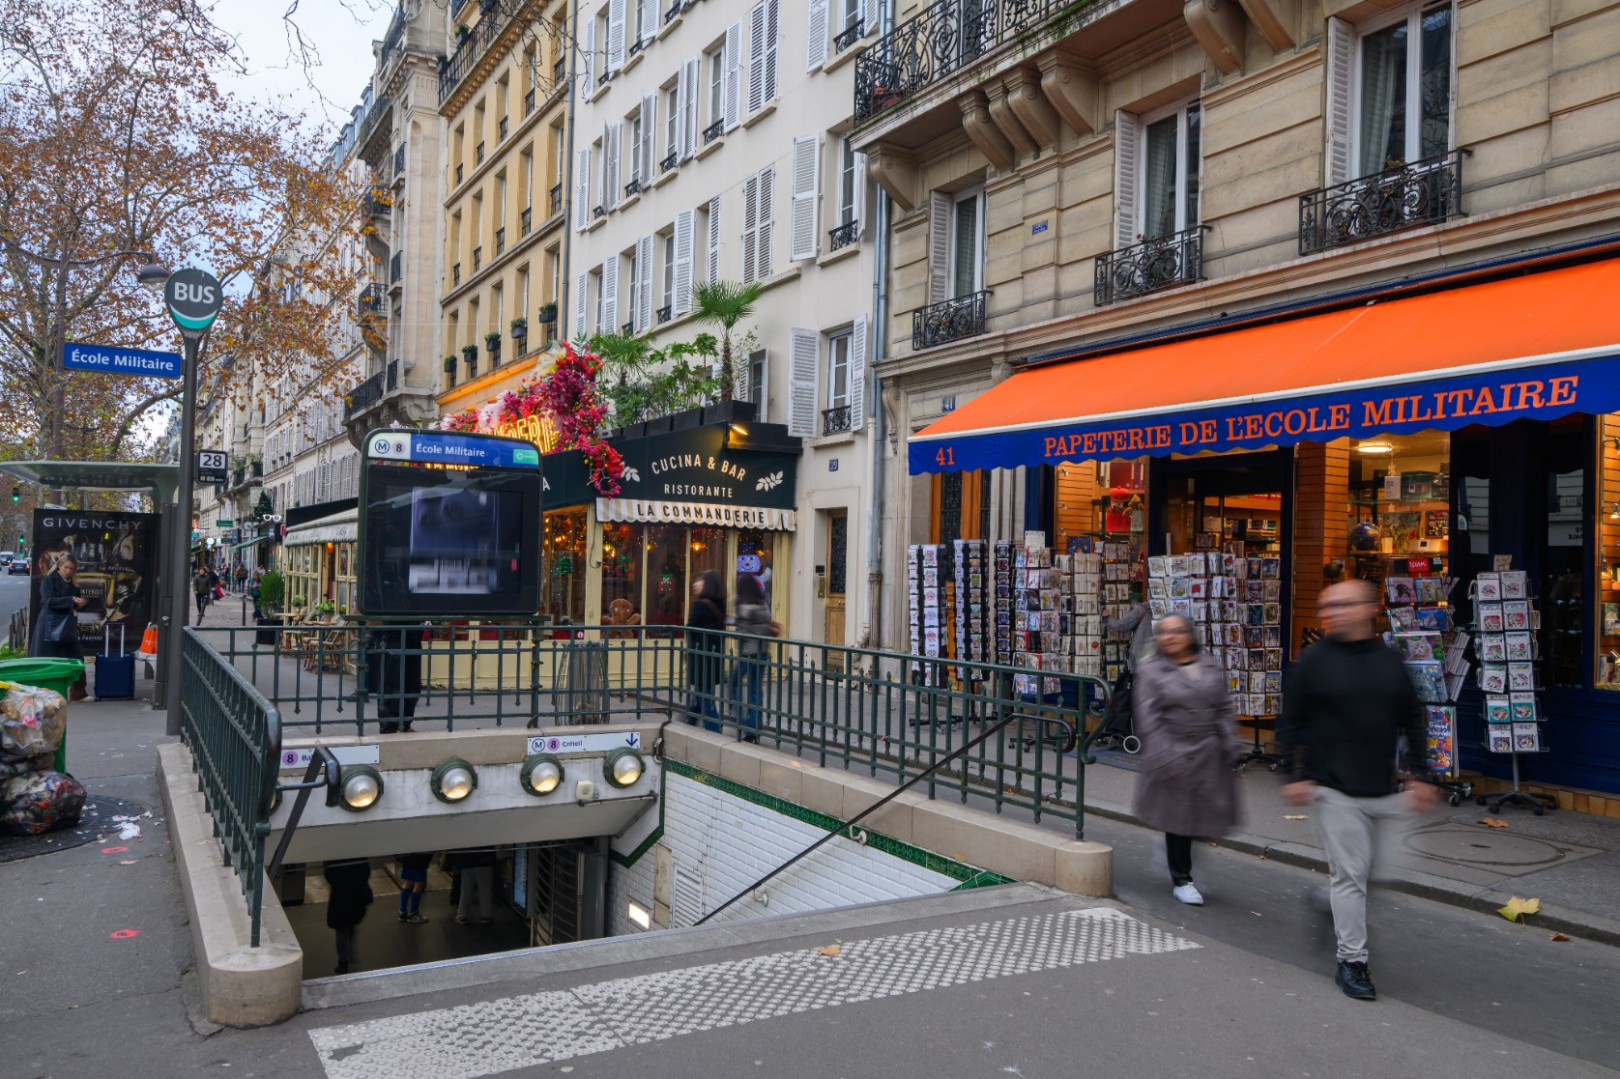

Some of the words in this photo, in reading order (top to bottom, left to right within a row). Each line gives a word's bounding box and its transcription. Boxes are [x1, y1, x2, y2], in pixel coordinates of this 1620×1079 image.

[174, 282, 215, 304] BUS
[71, 349, 110, 365] École
[114, 354, 174, 371] Militaire
[1044, 424, 1171, 457] PAPETERIE
[1179, 419, 1217, 446] DE
[1225, 404, 1350, 441] L'ECOLE
[1361, 375, 1579, 427] MILITAIRE
[396, 444, 402, 453] 8
[416, 443, 442, 454] École
[444, 446, 485, 457] Militaire
[935, 446, 955, 466] 41
[203, 454, 222, 467] 28
[651, 454, 701, 475] CUCINA
[707, 456, 716, 470] &
[721, 459, 747, 482] BAR
[664, 483, 733, 498] RISTORANTE
[637, 503, 654, 517] LA
[663, 505, 765, 524] COMMANDERIE
[43, 517, 141, 530] GIVENCHY
[550, 740, 556, 749] 8
[562, 740, 583, 748] Créteil
[286, 754, 294, 763] 8
